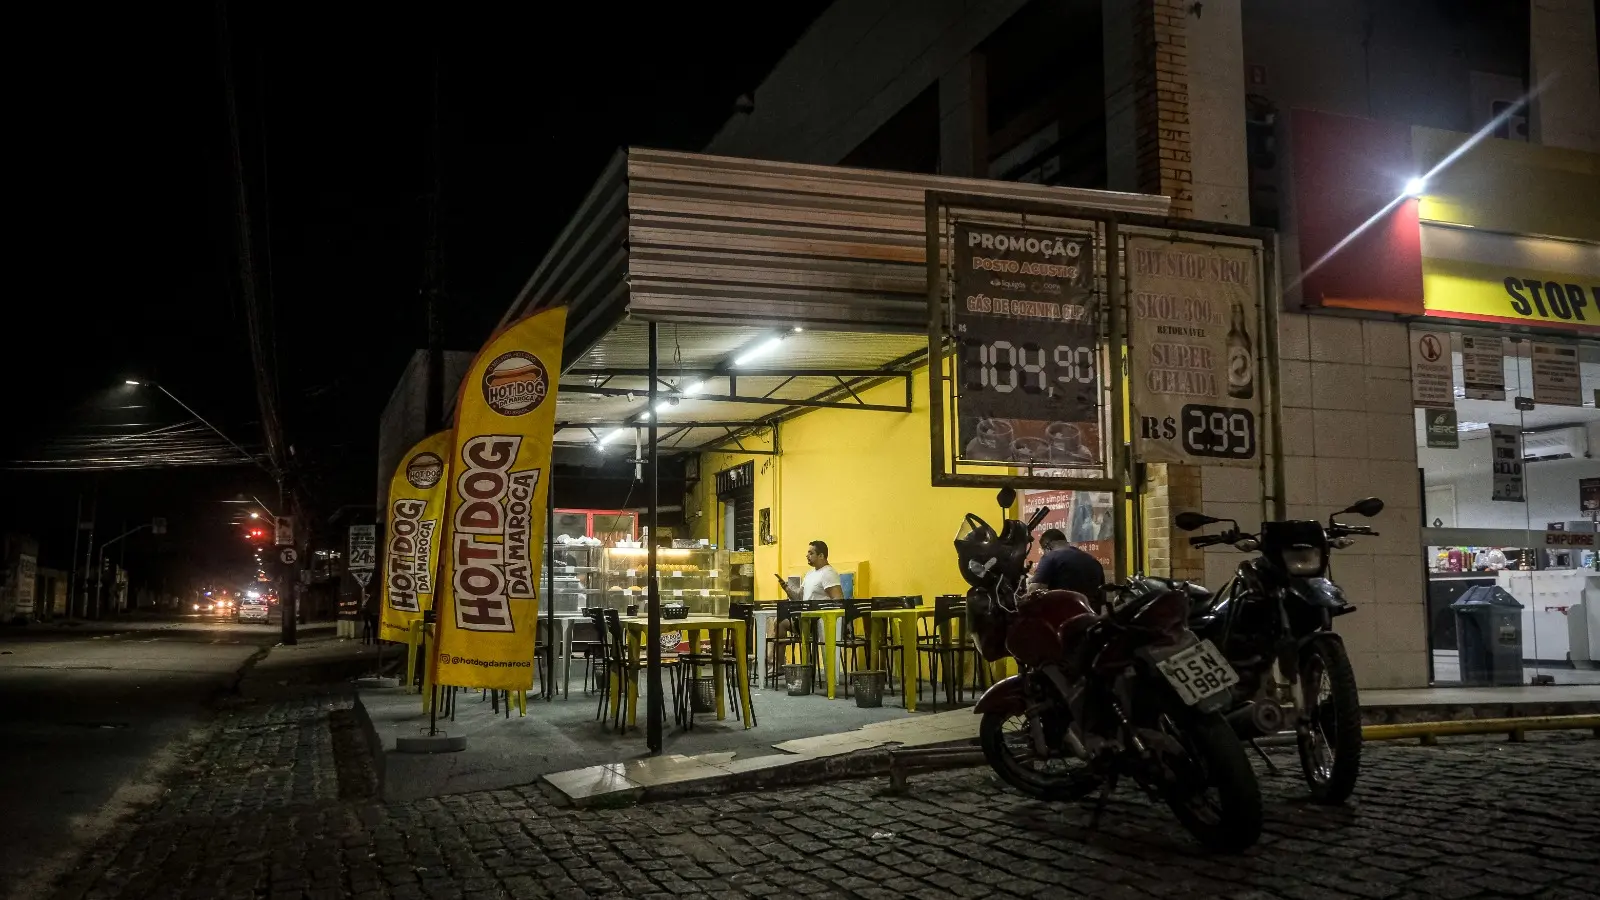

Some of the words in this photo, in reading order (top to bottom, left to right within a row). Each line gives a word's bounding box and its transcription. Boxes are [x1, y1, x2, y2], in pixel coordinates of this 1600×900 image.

[968, 231, 1081, 259] PROMOÇÃO
[972, 256, 1020, 273] POSTO
[1165, 251, 1208, 281] STOP
[966, 294, 992, 312] GÁS
[993, 298, 1010, 314] DE
[1011, 300, 1061, 319] COZINHA
[1136, 292, 1180, 320] SKOL
[1503, 276, 1588, 321] STOP
[1157, 325, 1207, 338] RETORNÁVEL
[1151, 342, 1216, 370] SUPER
[489, 383, 515, 404] HOT
[516, 381, 545, 396] DOG
[1147, 367, 1221, 398] GELADA
[508, 395, 535, 404] MAROCA
[1141, 414, 1177, 441] R$
[458, 439, 516, 530] DOG
[391, 502, 423, 554] DOG
[508, 473, 535, 561] MAROCA
[416, 521, 434, 573] MAROCA
[1546, 533, 1594, 545] EMPURRE
[390, 556, 417, 609] HOT
[416, 573, 429, 592] DA
[457, 536, 508, 628] HOT
[510, 563, 530, 596] DA
[451, 656, 531, 668] @hotdogdamaroca
[1184, 667, 1232, 699] 1982
